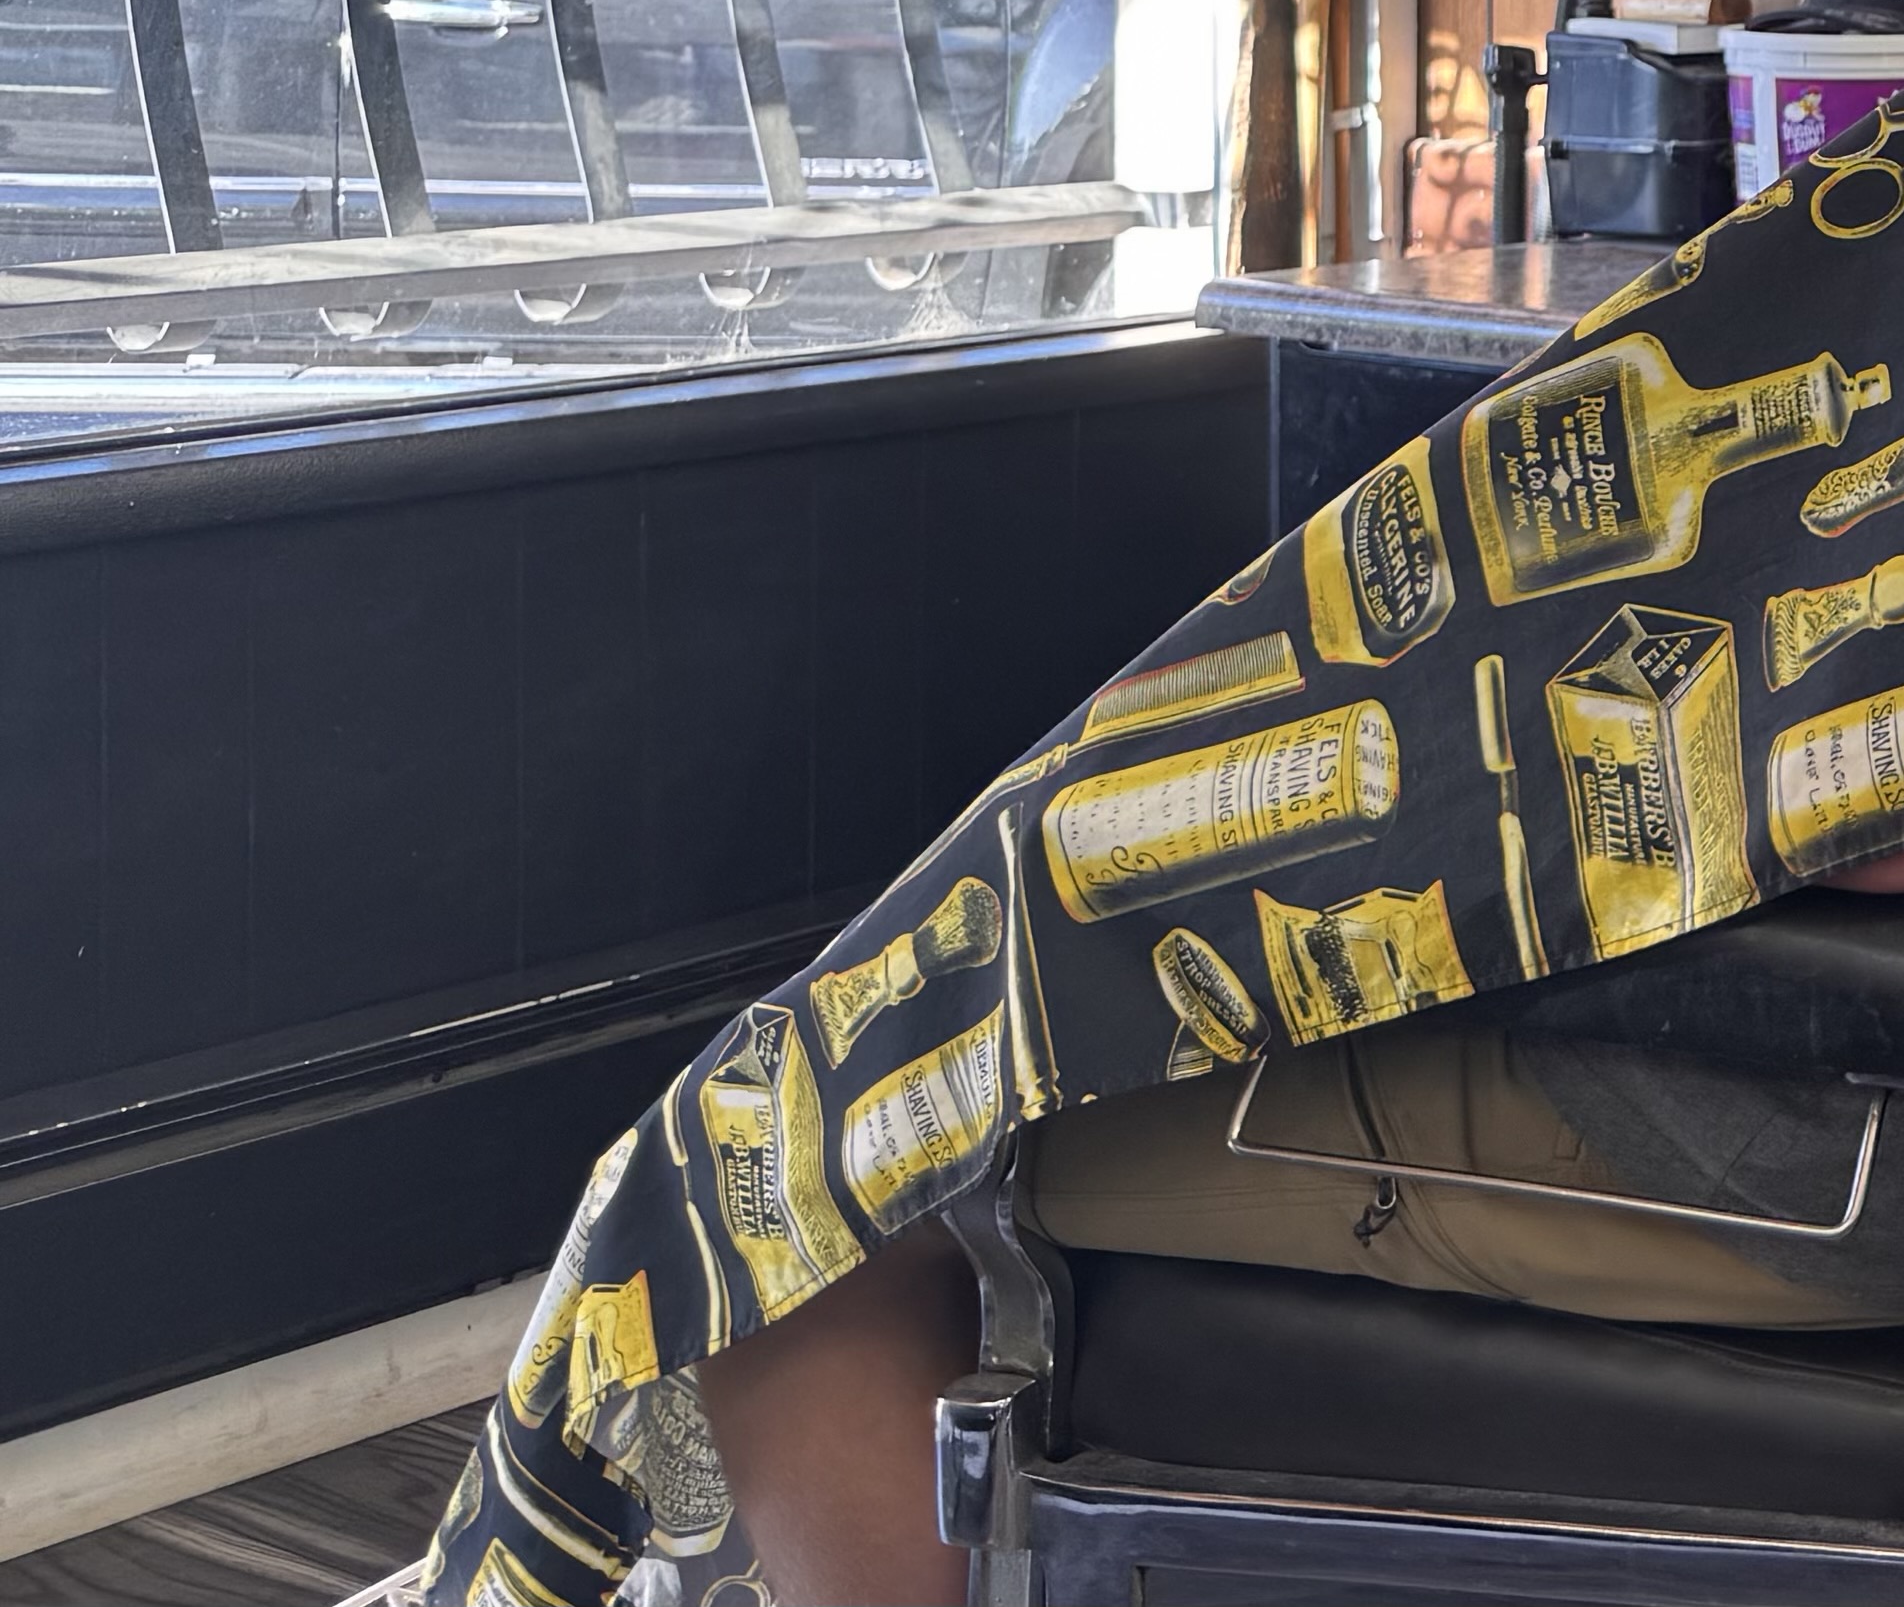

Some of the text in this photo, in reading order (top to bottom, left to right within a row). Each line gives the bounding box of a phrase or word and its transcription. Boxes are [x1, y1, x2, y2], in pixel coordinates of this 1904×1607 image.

[1524, 451, 1543, 465] &
[1526, 466, 1548, 497] Co.
[1397, 474, 1423, 522] FELS
[1378, 469, 1416, 630] GLYCERINE
[1408, 526, 1426, 544] &
[1286, 717, 1325, 813] SHAVING
[1316, 721, 1343, 784] FELS
[1869, 701, 1901, 788] SHAVING
[1216, 741, 1245, 824] SHAVING
[1176, 940, 1212, 989] STROP
[904, 1069, 943, 1150] SHAVING
